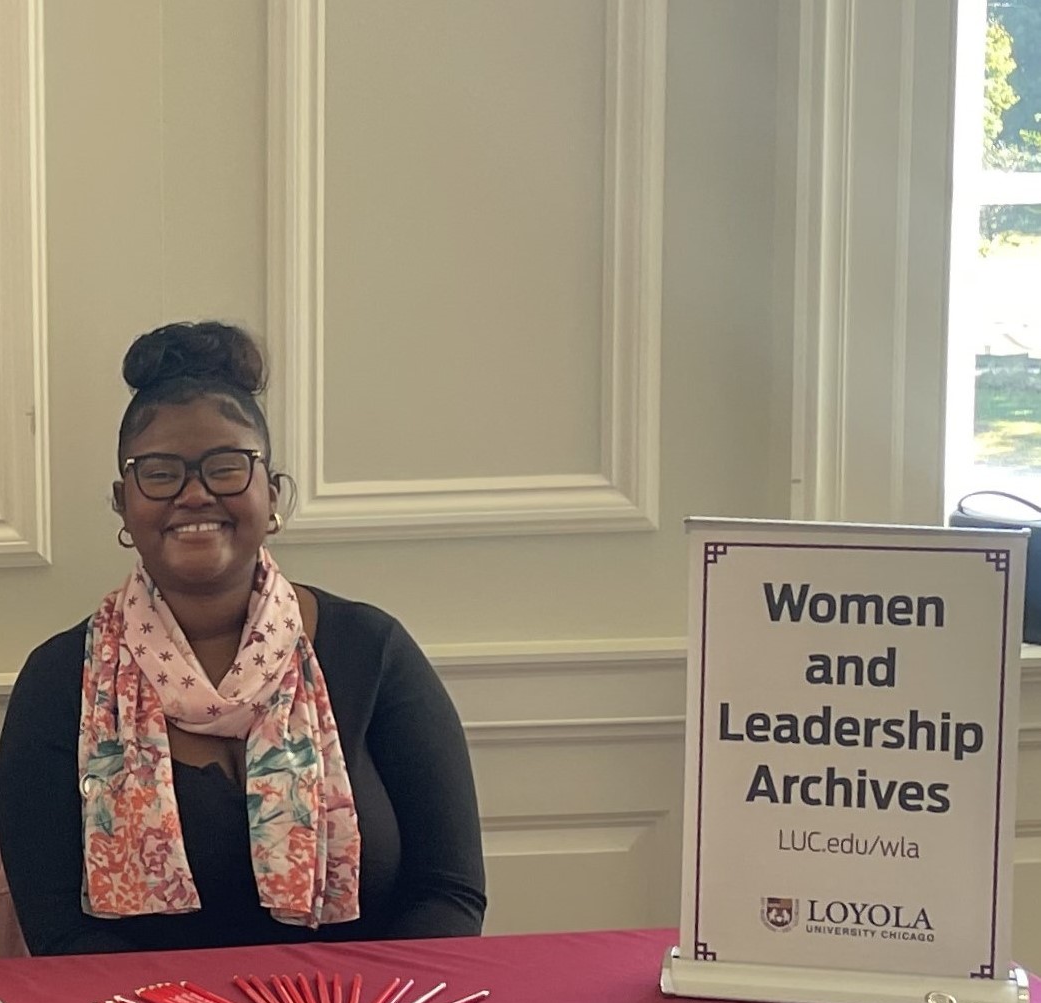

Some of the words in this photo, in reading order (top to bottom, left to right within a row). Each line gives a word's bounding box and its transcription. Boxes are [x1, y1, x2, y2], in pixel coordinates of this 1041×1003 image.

[763, 582, 945, 628] Women
[805, 647, 897, 688] and
[719, 702, 984, 760] Leadership
[745, 764, 951, 814] Archives
[778, 829, 920, 859] LUC.edu/wla
[806, 925, 876, 938] UNIVERSITY
[881, 931, 935, 942] CHICAGO
[807, 900, 934, 930] LOYOLA
